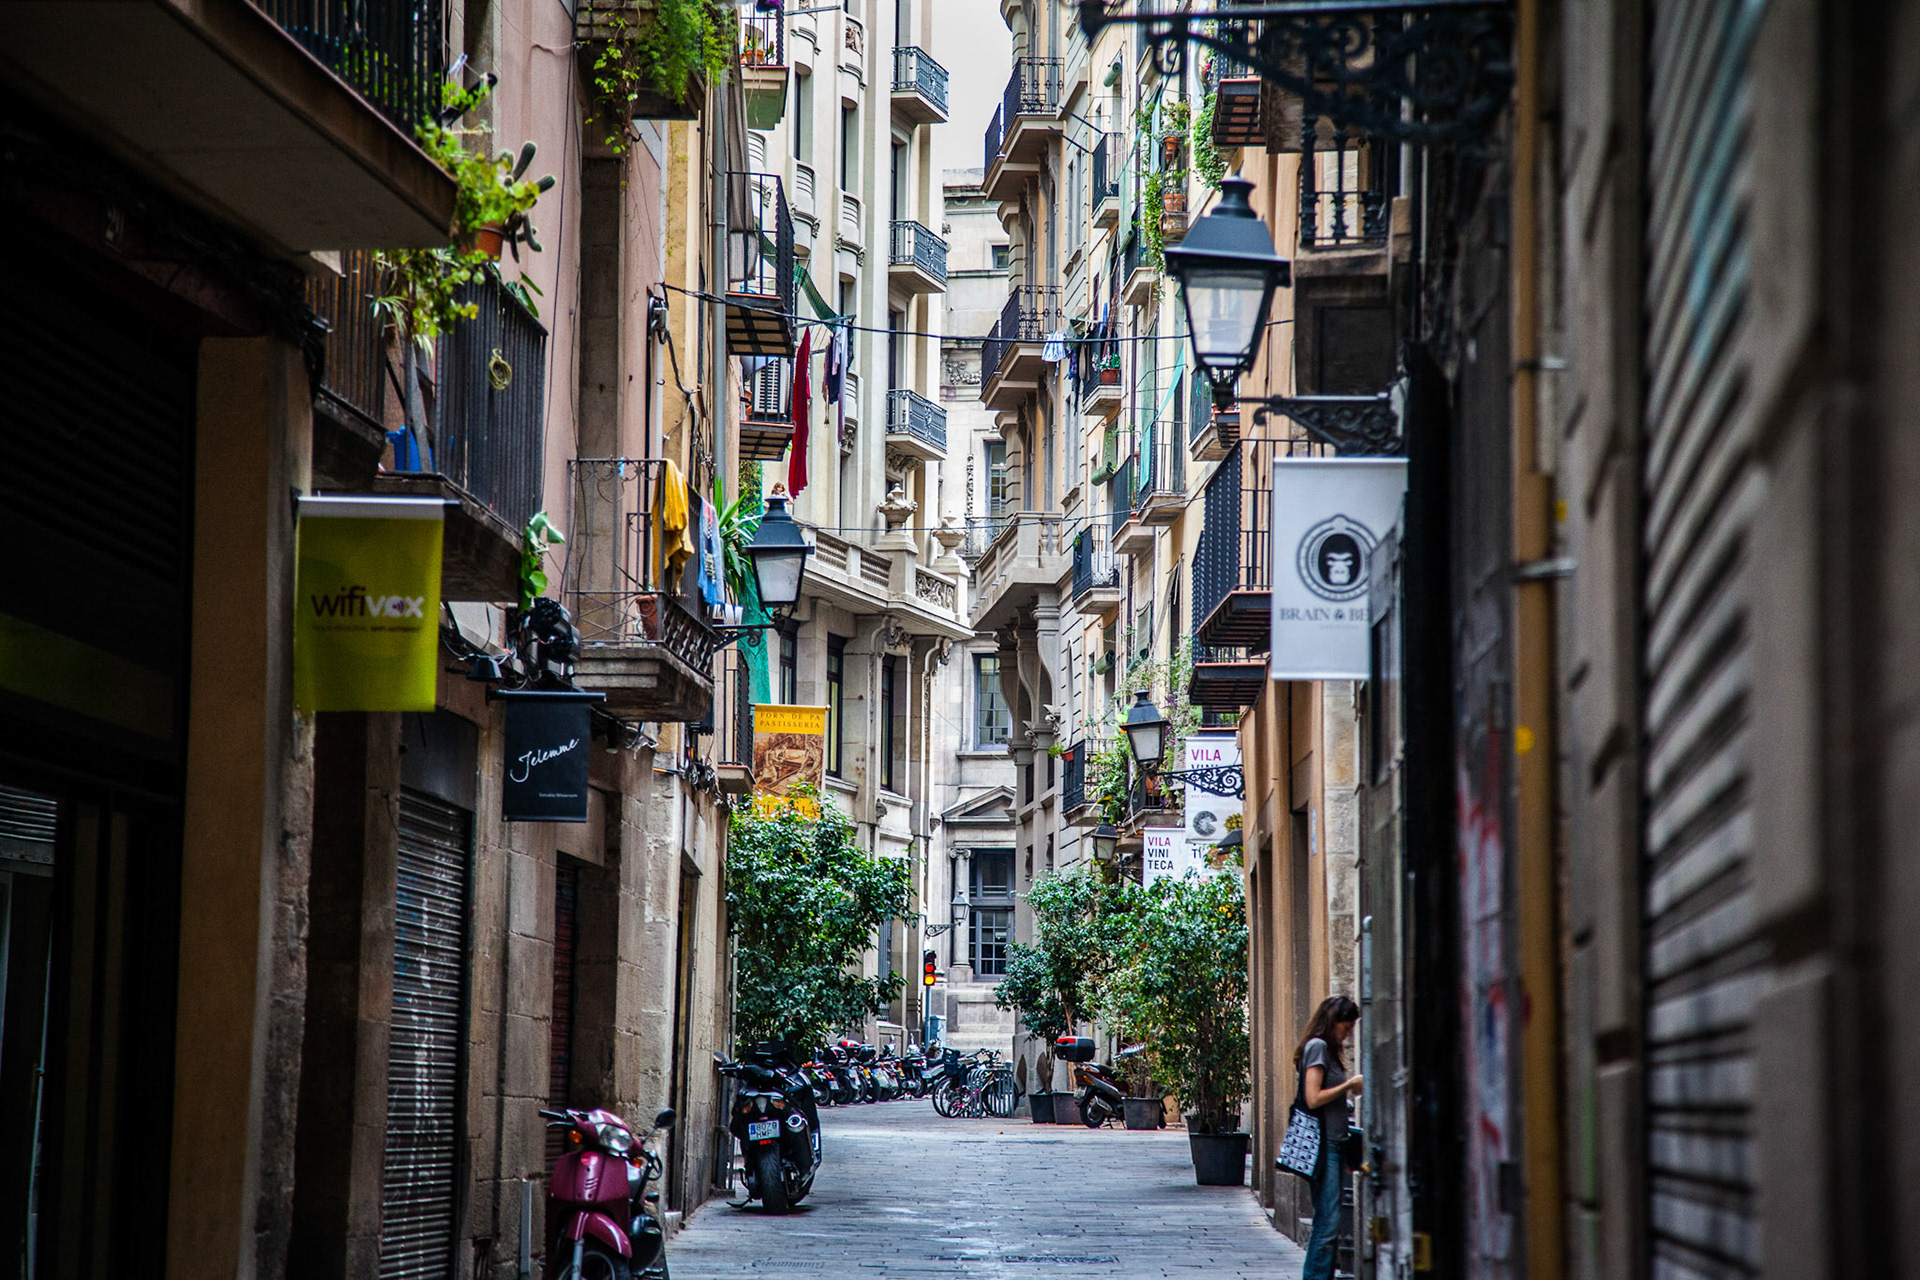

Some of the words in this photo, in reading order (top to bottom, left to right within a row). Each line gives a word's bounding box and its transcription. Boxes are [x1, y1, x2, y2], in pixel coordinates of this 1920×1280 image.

[1280, 608, 1329, 621] BRAIN
[1334, 608, 1346, 621] &
[760, 720, 821, 729] PASTISSERIA
[1191, 749, 1222, 761] VILA
[1148, 836, 1171, 846] VILA
[1148, 848, 1169, 858] VINI
[1148, 860, 1174, 870] TECA
